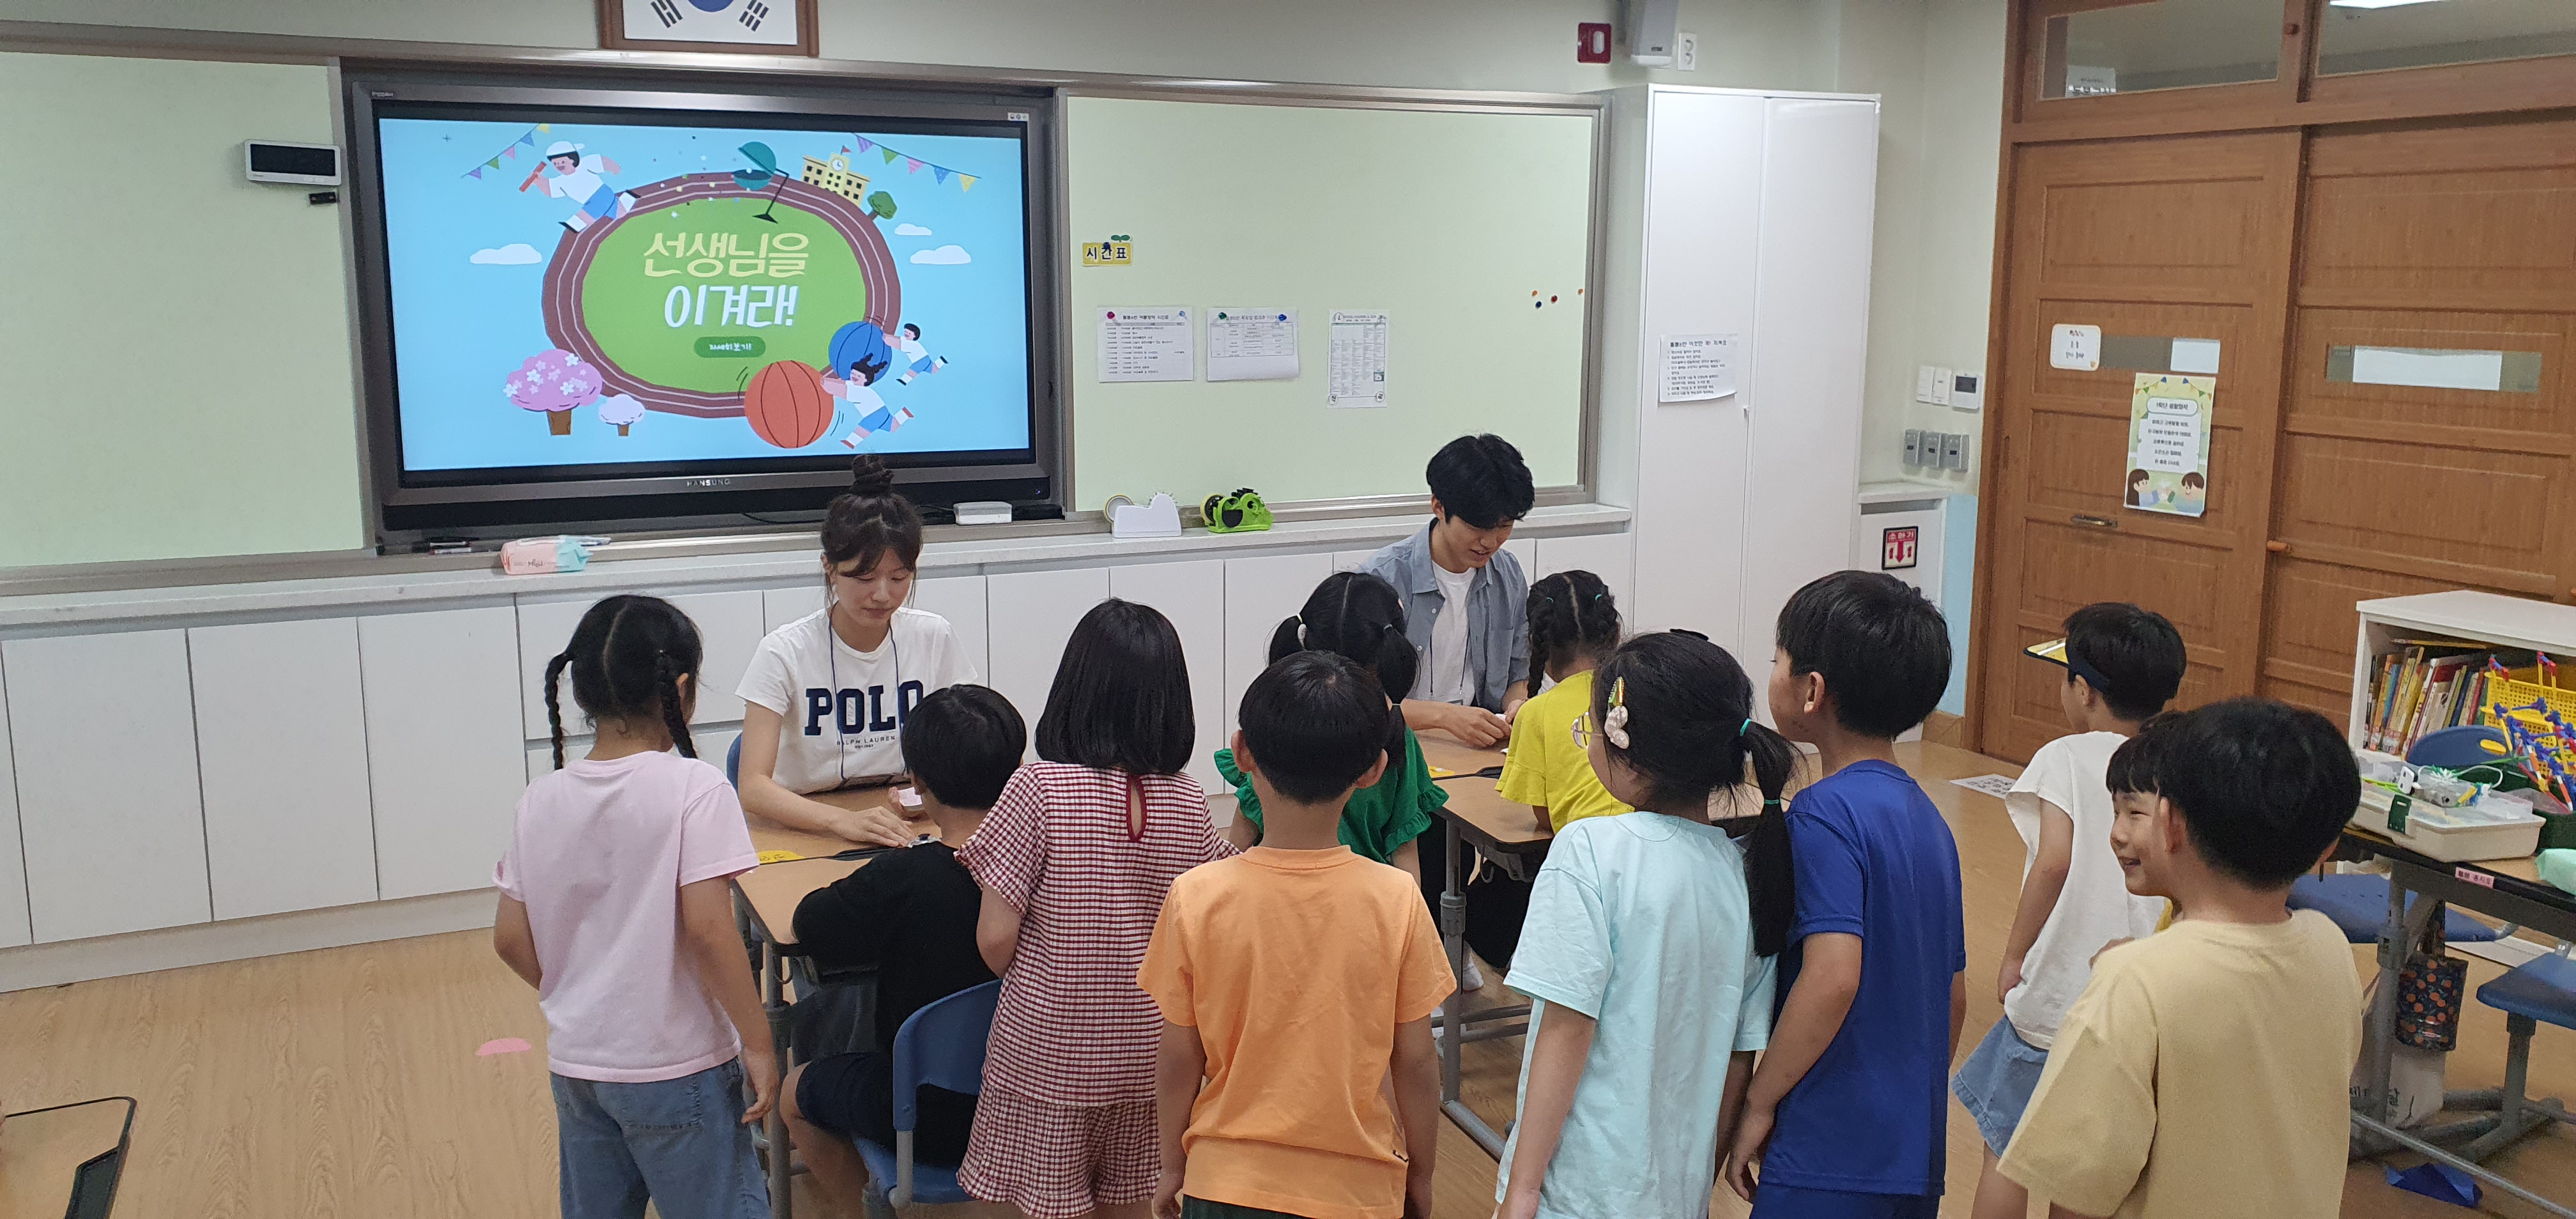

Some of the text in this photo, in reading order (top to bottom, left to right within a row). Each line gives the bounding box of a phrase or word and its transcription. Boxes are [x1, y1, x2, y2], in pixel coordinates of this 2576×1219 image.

[643, 233, 809, 277] 선생님을
[1086, 247, 1127, 260] 시간표
[664, 284, 798, 328] 이겨라!
[804, 680, 924, 735] POLO
[864, 735, 895, 744] LAUREN
